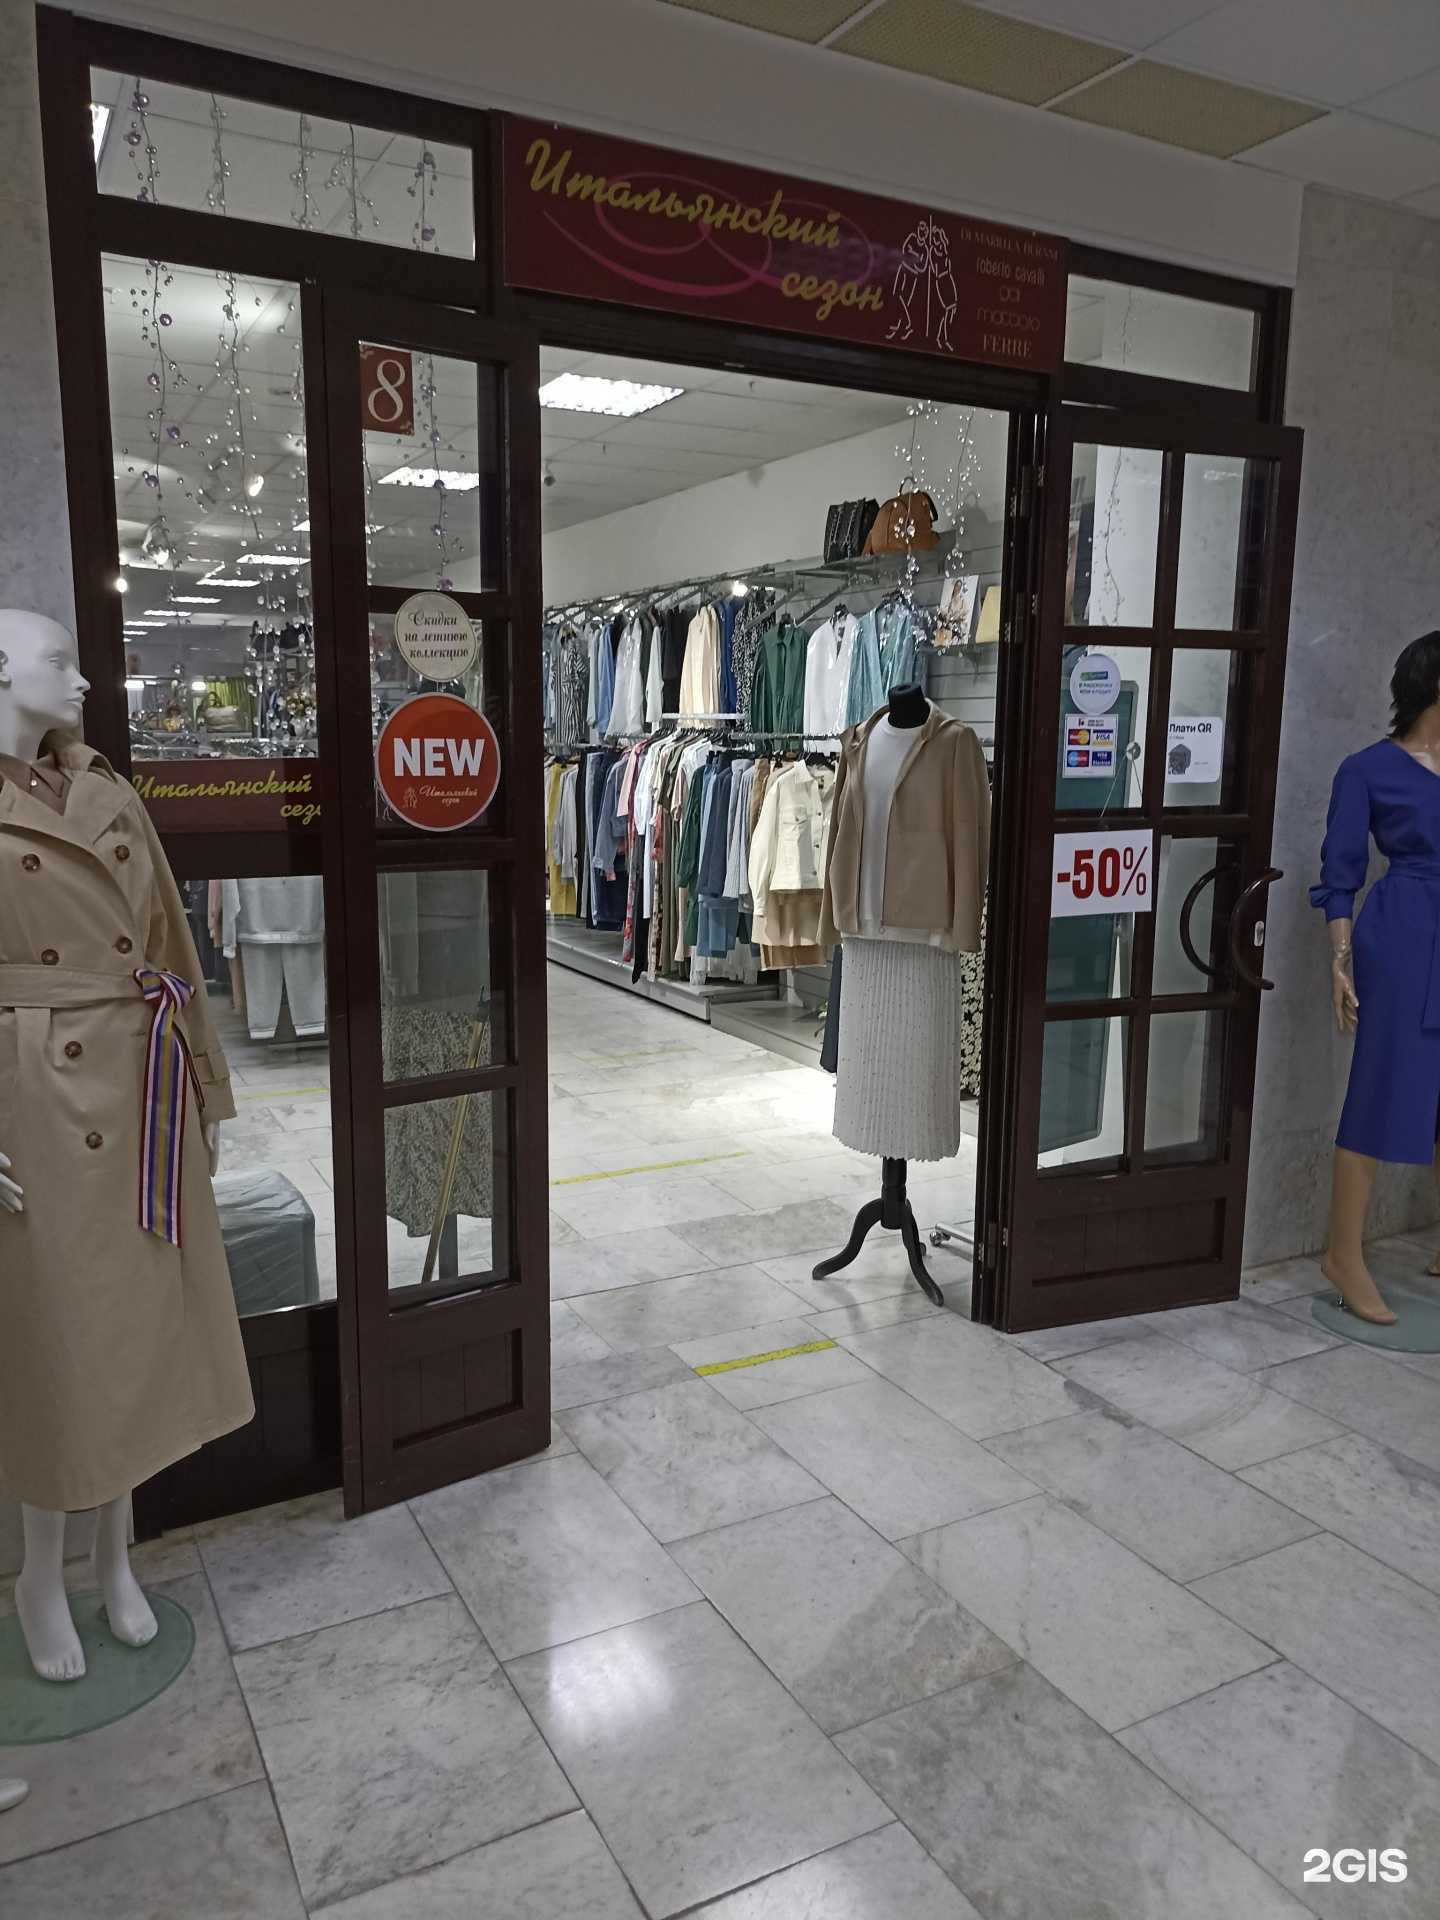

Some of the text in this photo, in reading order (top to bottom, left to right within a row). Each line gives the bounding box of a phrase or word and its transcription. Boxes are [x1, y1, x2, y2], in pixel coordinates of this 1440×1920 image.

[526, 138, 842, 248] Итальянский
[976, 256, 1046, 288] roberto cavalli
[781, 270, 884, 321] сезон
[367, 358, 406, 423] 8
[408, 609, 457, 626] Скидки
[404, 632, 468, 642] на летнюю
[409, 648, 469, 661] коллекцию
[1169, 722, 1212, 734] Плати QR
[393, 737, 486, 778] NEW
[131, 769, 313, 799] Итальянский
[1057, 846, 1148, 899] -50%
